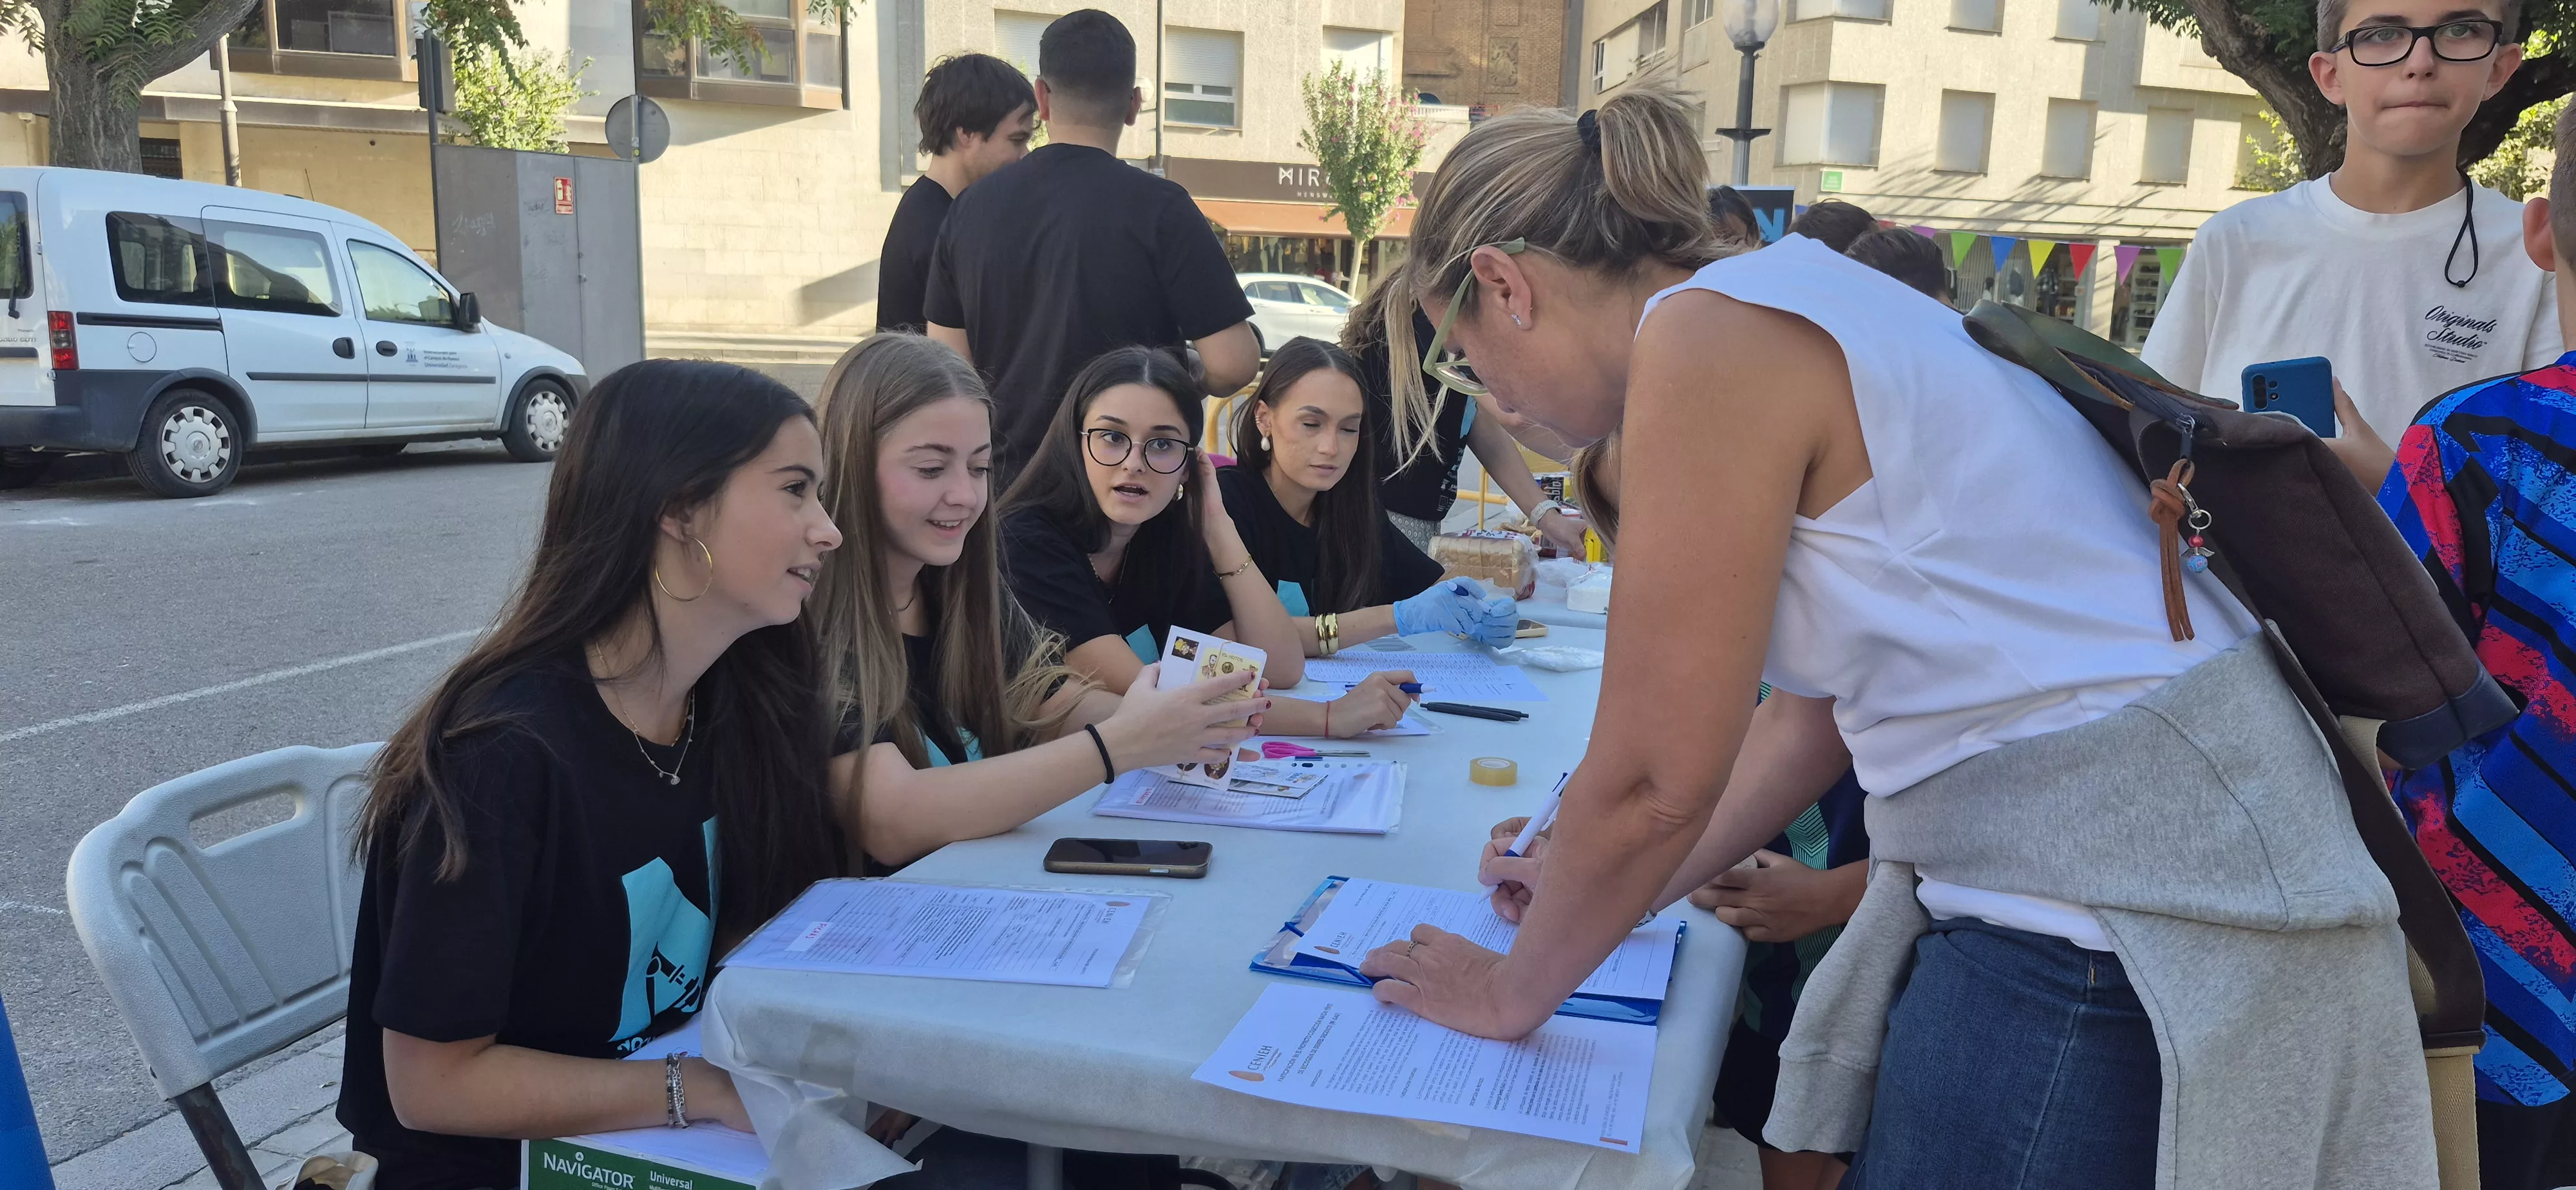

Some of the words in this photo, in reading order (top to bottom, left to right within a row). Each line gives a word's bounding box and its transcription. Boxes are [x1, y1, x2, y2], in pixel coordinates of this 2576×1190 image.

[2425, 305, 2497, 334] Originals
[2427, 327, 2484, 350] Studio
[1247, 1044, 1273, 1070] CENIEH
[544, 1151, 634, 1189] NAVIGATOR
[650, 1169, 693, 1190] Universal
